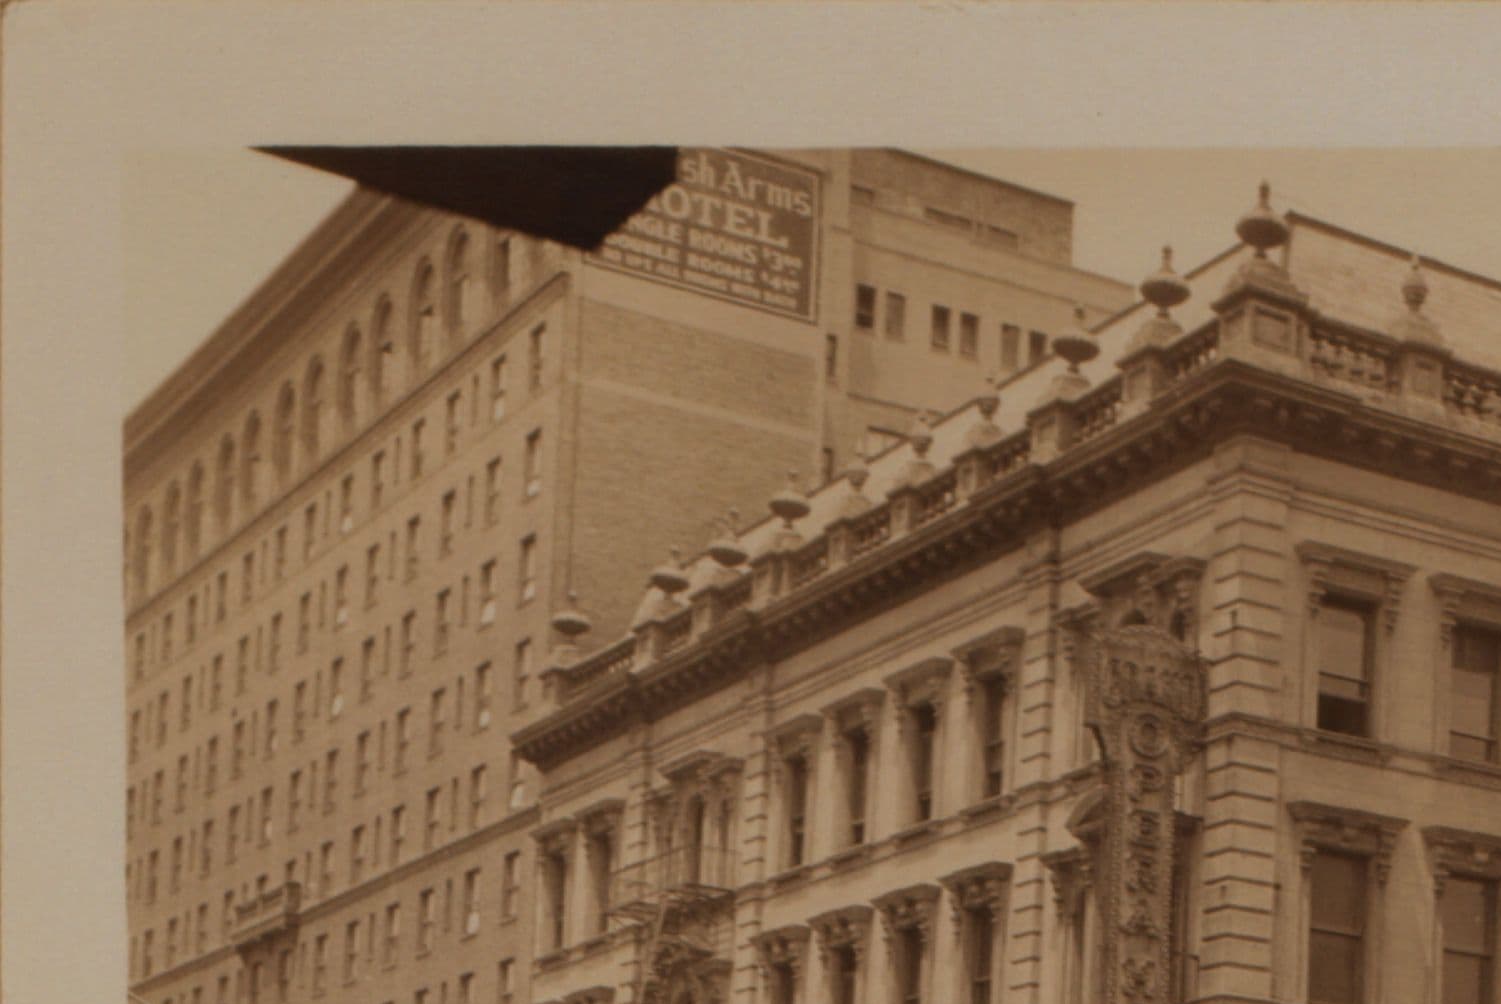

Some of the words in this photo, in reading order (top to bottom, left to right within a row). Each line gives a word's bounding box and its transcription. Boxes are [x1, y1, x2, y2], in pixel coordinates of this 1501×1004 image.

[644, 184, 790, 249] OTEL
[721, 160, 813, 218] Arms
[625, 213, 683, 244] NGLE
